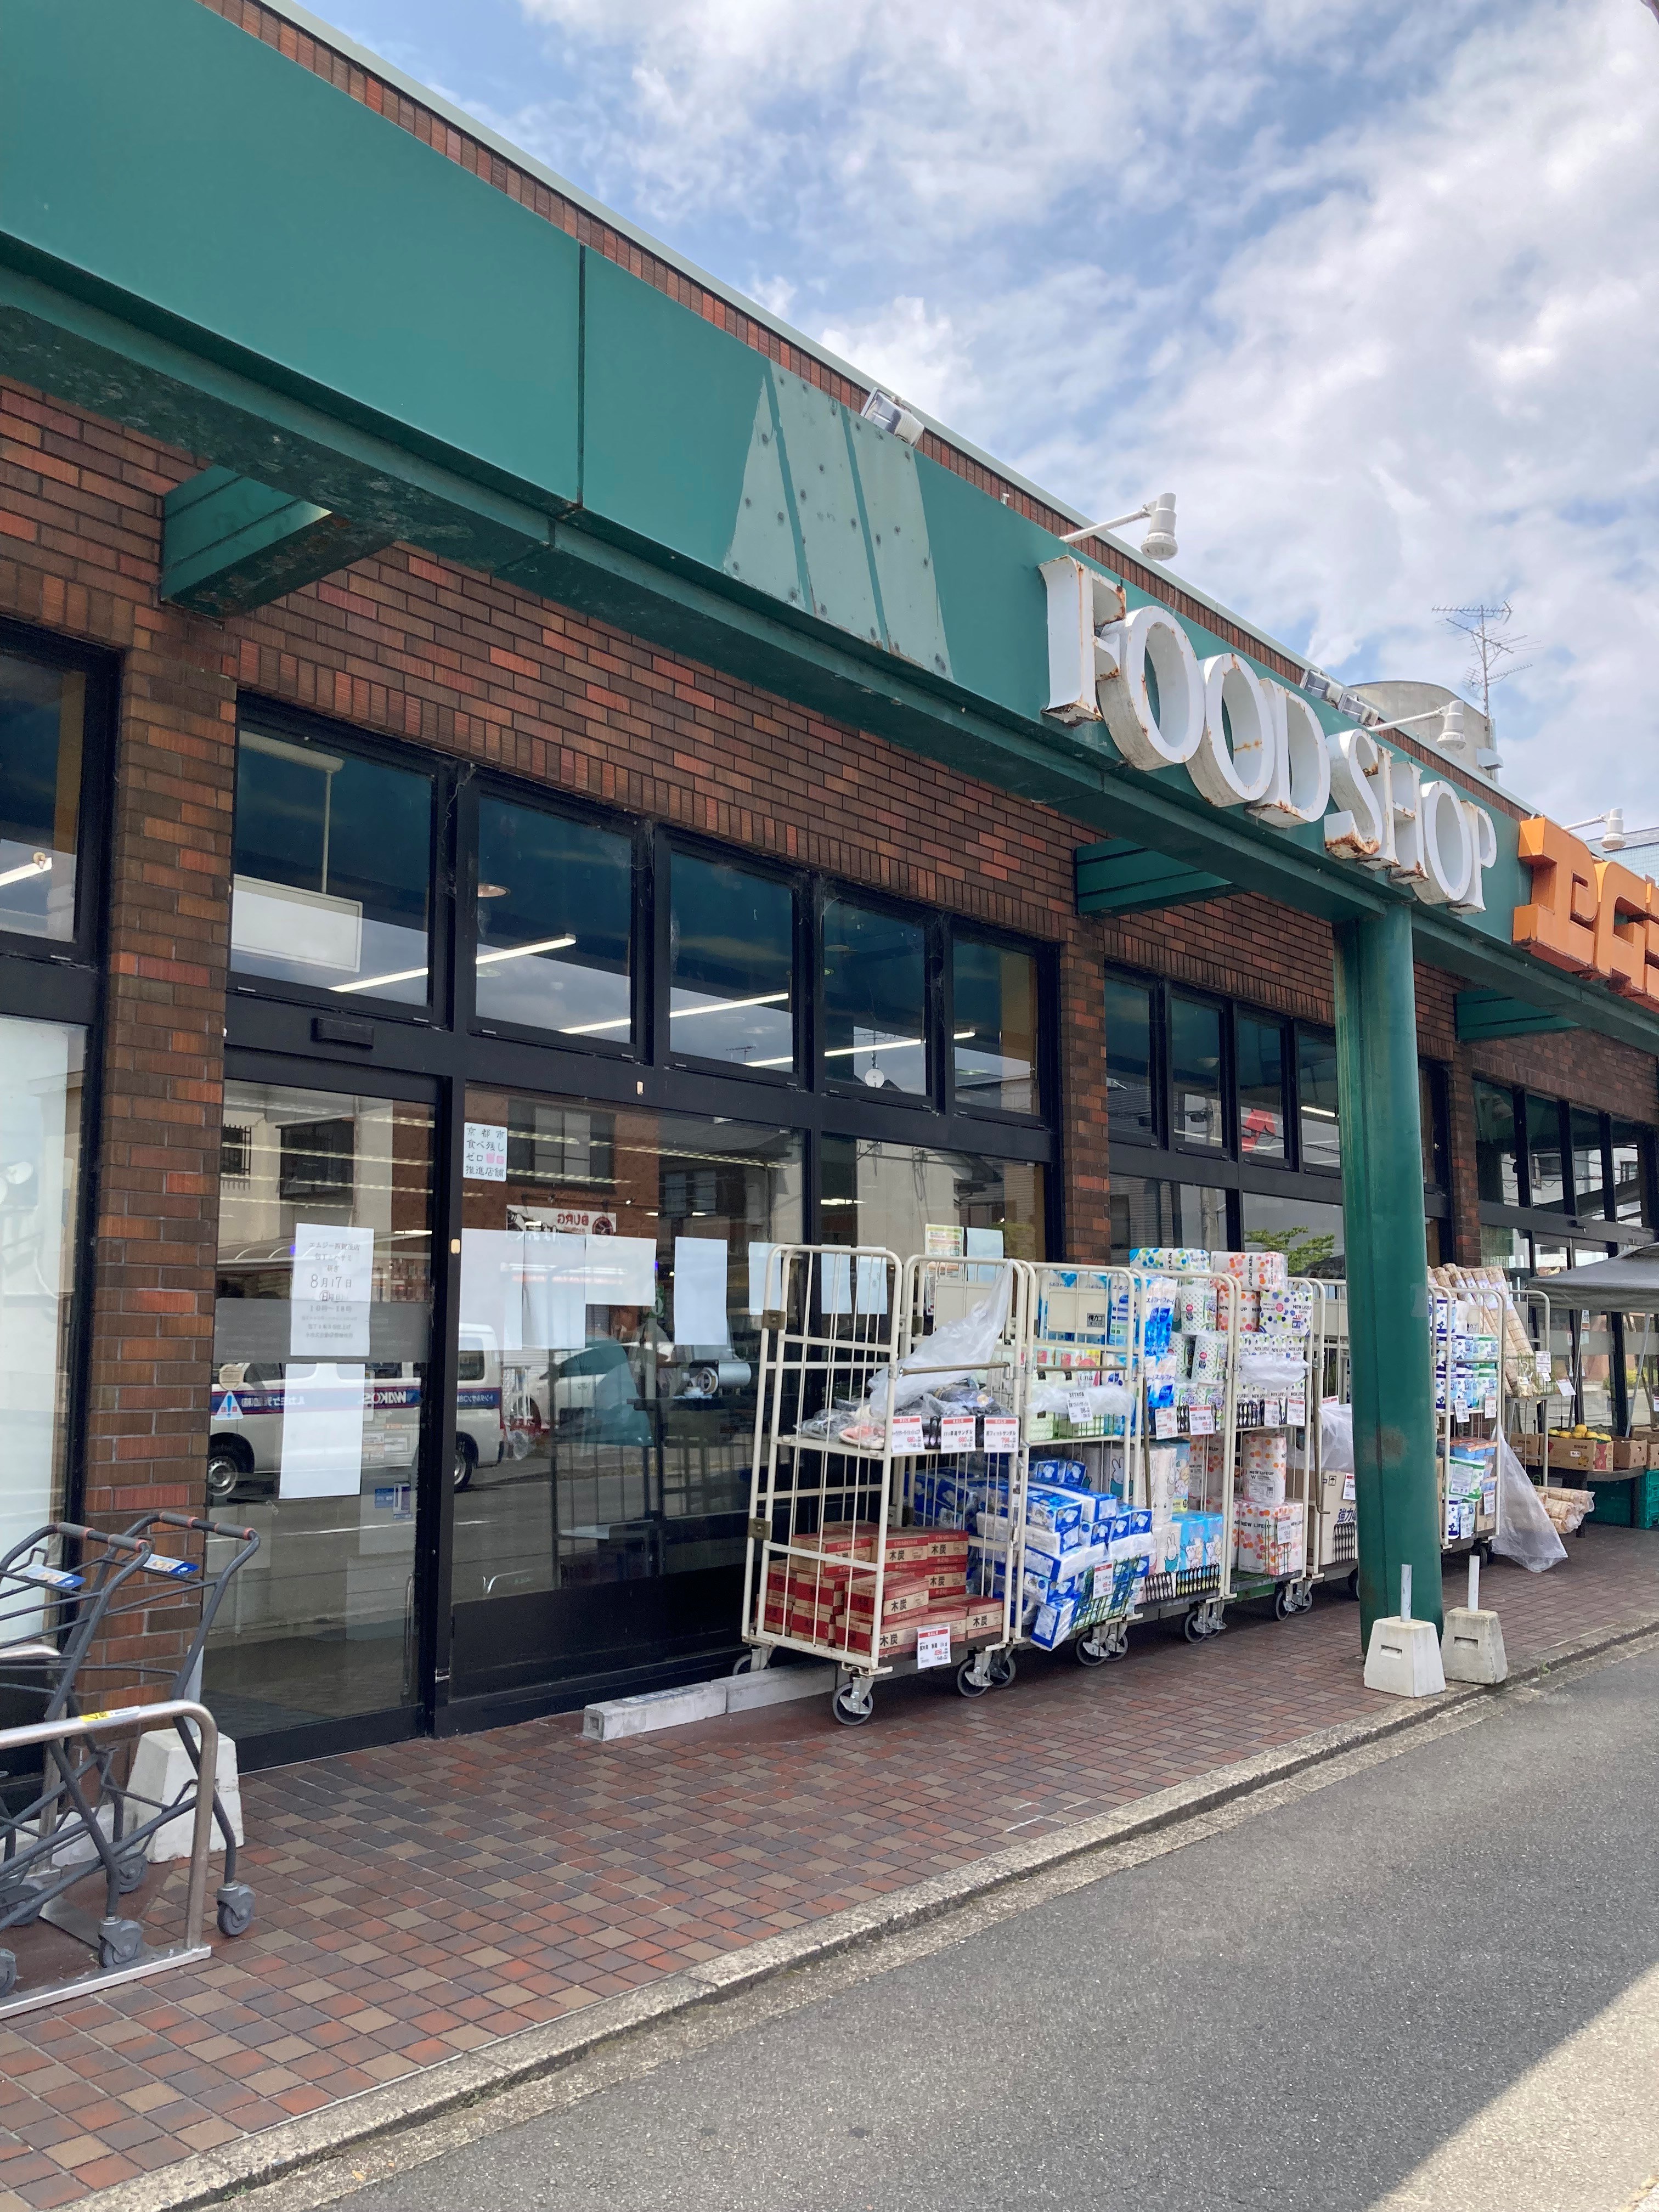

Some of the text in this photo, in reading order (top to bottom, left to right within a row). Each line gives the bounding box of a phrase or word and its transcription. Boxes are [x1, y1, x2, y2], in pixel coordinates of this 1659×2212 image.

[1039, 554, 1497, 915] FOOD SHOP
[467, 1126, 505, 1139] 京都市
[466, 1139, 504, 1152] 食べ残し
[466, 1165, 504, 1177] 推進店舗
[311, 1274, 352, 1288] 8月17日
[889, 1550, 905, 1561] 木炭
[932, 1544, 946, 1555] 木炭
[930, 1576, 945, 1587] 木炭
[891, 1598, 907, 1612] 木炭
[973, 1615, 988, 1627] 木炭
[879, 1633, 898, 1646] 木炭
